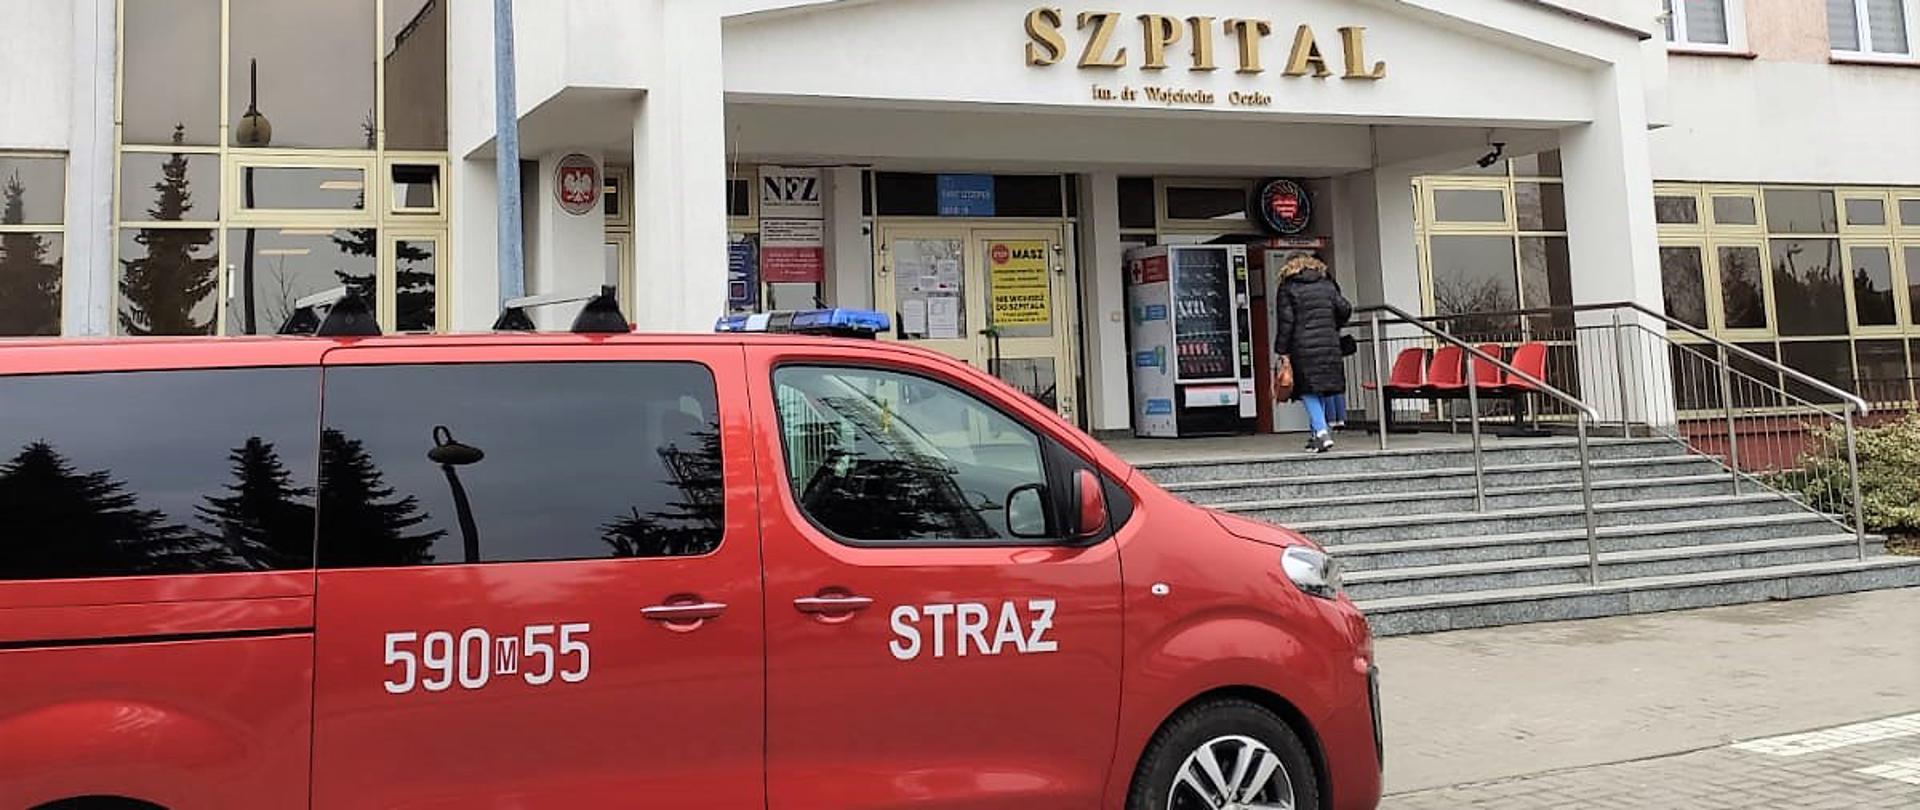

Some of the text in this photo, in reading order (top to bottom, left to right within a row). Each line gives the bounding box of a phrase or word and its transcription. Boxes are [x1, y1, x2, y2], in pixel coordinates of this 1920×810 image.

[1024, 8, 1386, 79] SZPITAL
[1121, 86, 1138, 101] dr
[1144, 87, 1214, 105] Wojciecha
[1012, 249, 1044, 259] MASZ
[996, 303, 1045, 311] DO SZPITALA
